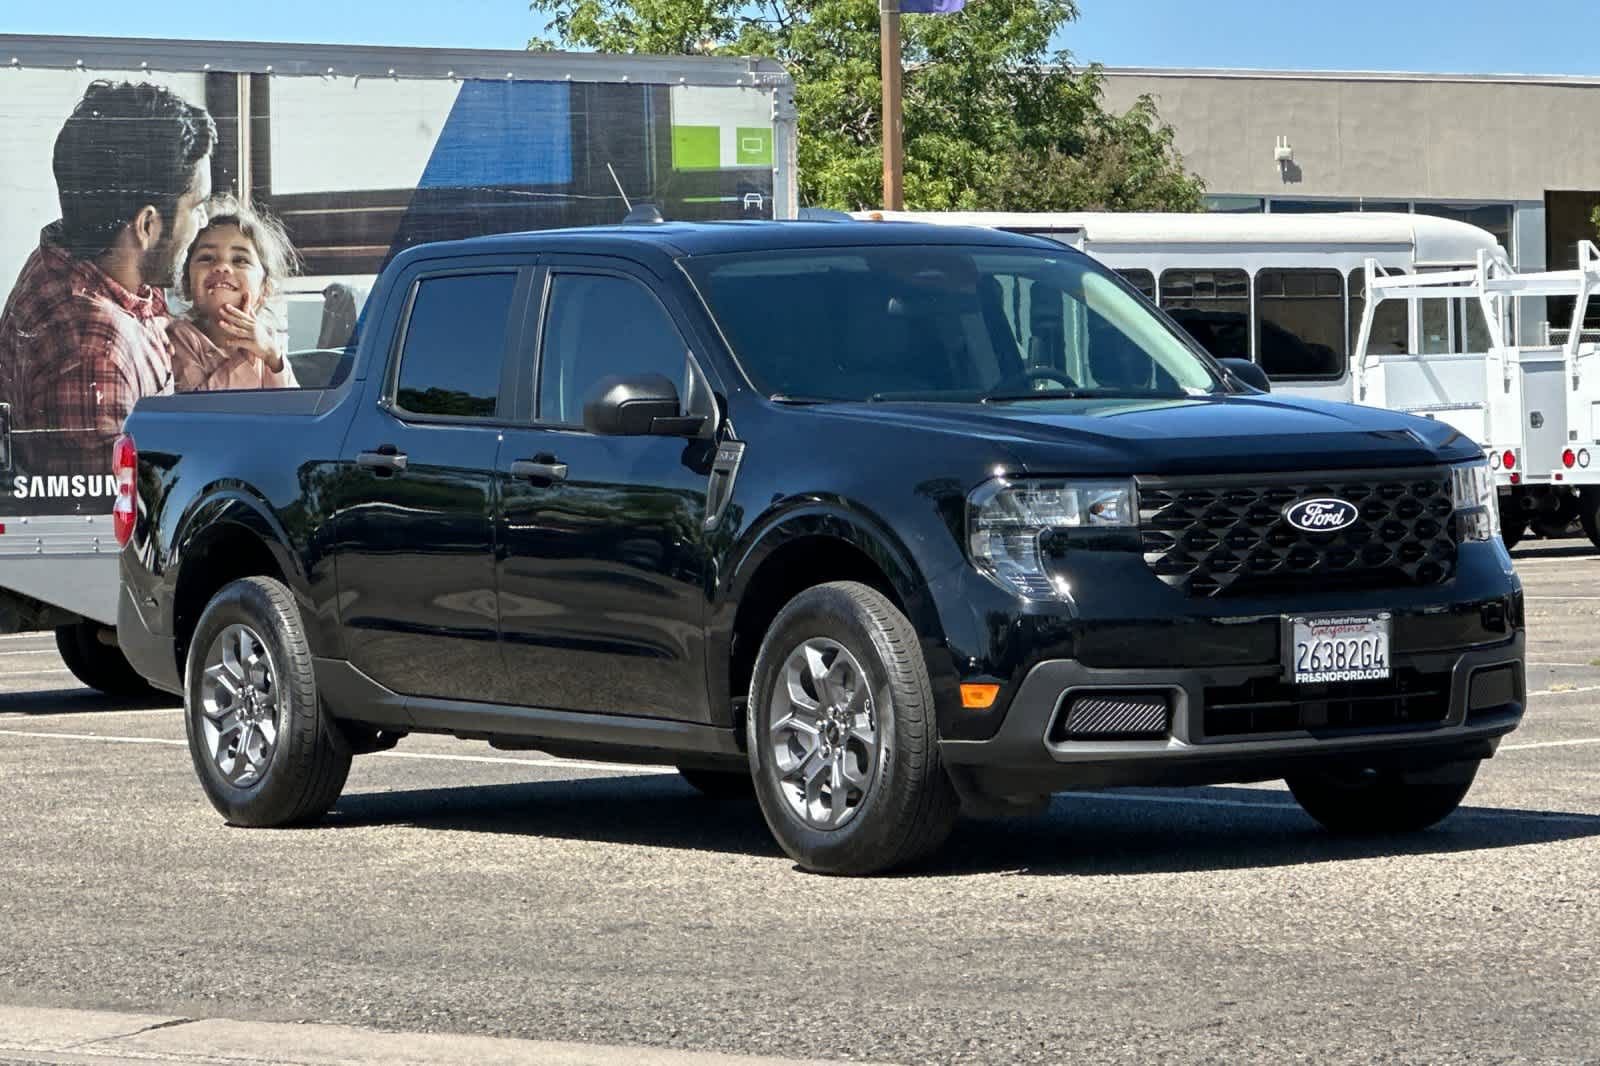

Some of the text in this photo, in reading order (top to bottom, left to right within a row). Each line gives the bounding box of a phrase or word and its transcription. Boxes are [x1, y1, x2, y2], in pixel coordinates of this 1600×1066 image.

[1301, 503, 1346, 526] Ford
[1297, 638, 1384, 672] 26382G4
[1295, 669, 1389, 683] FRESNOFORD.COM
